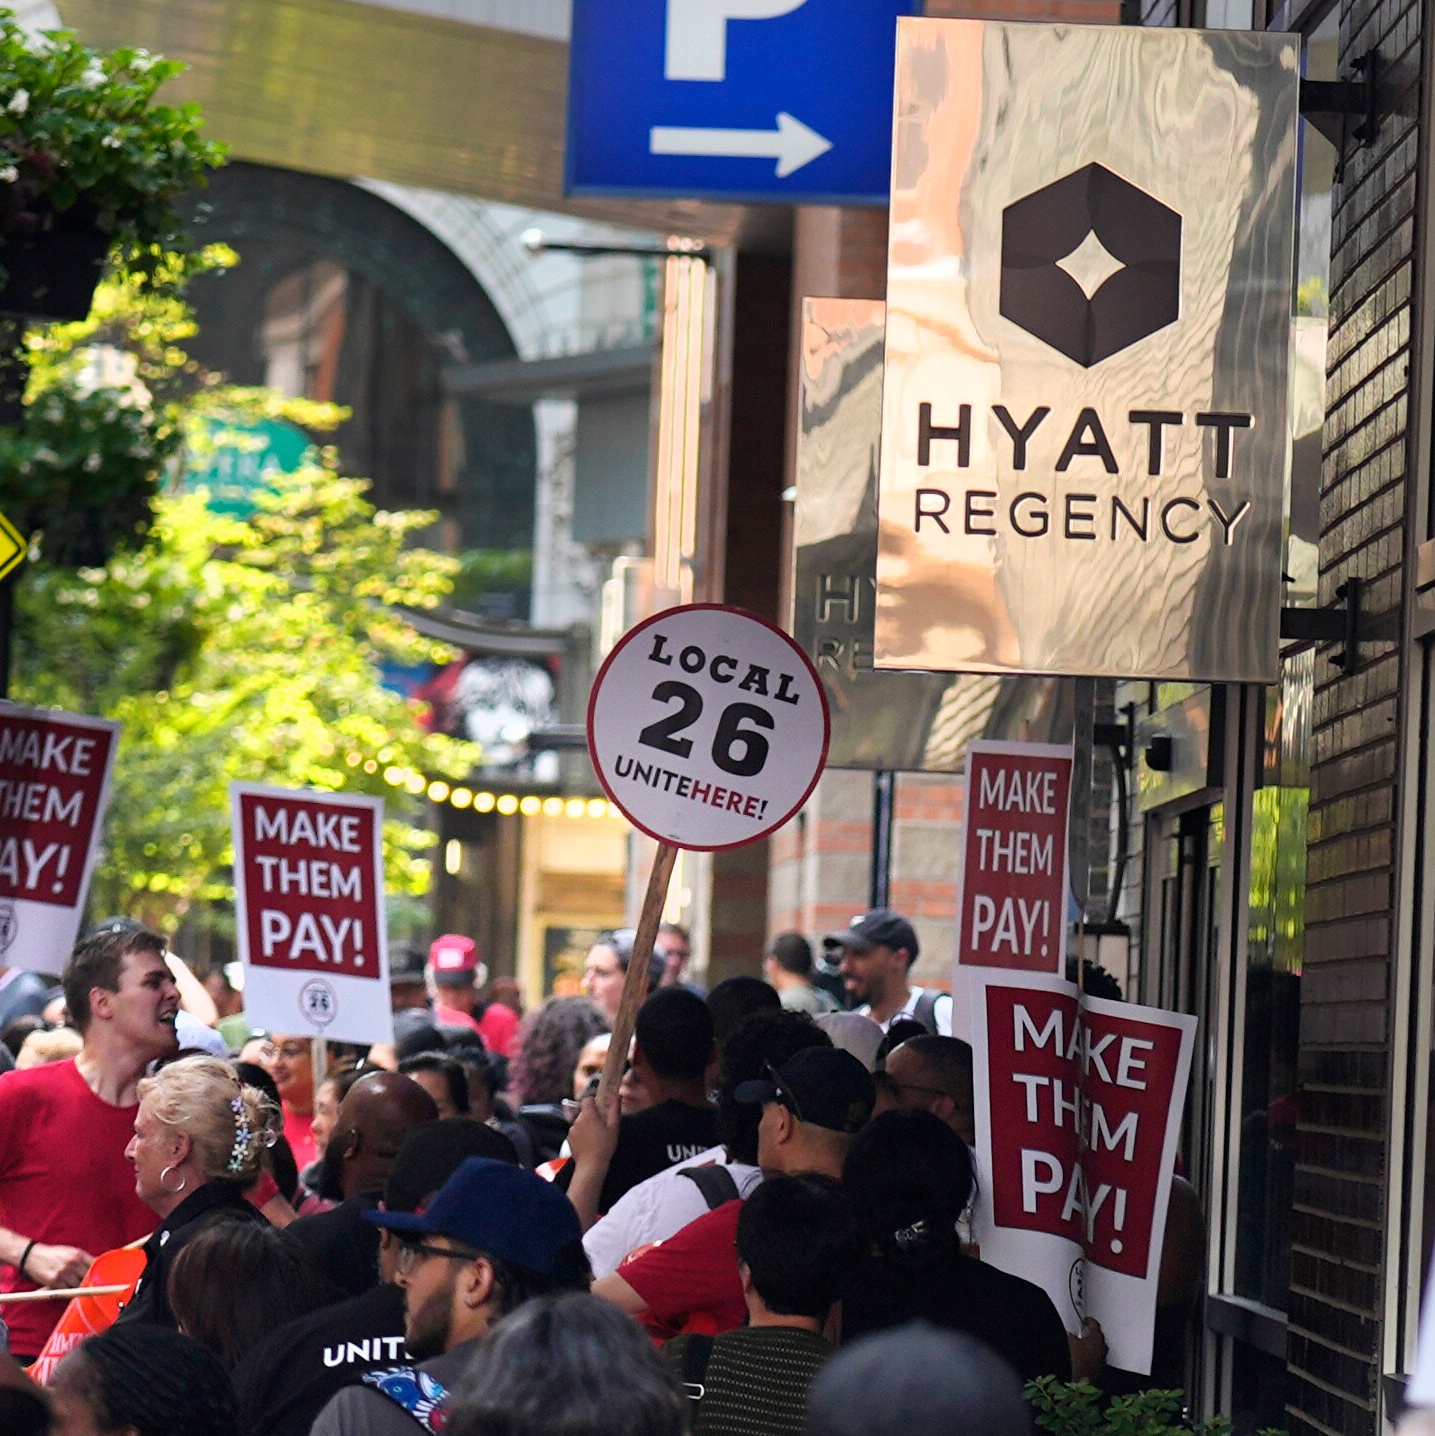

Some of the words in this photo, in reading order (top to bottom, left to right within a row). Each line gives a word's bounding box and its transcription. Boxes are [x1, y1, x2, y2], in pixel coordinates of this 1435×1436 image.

[917, 402, 1256, 480] HYATT
[913, 487, 1252, 547] REGENCY
[648, 634, 800, 705] LOCAL
[638, 680, 775, 777] 26
[614, 755, 768, 820] UNITEHERE!
[980, 767, 1058, 815] MAKE
[254, 805, 361, 854] MAKE
[976, 828, 1054, 877] THEM
[254, 853, 362, 902] THEM
[263, 908, 365, 967] PAY!
[970, 896, 1051, 958] PAY!
[1013, 1003, 1155, 1091] MAKE
[1012, 1072, 1139, 1163] THEM
[1021, 1148, 1128, 1255] PAY!
